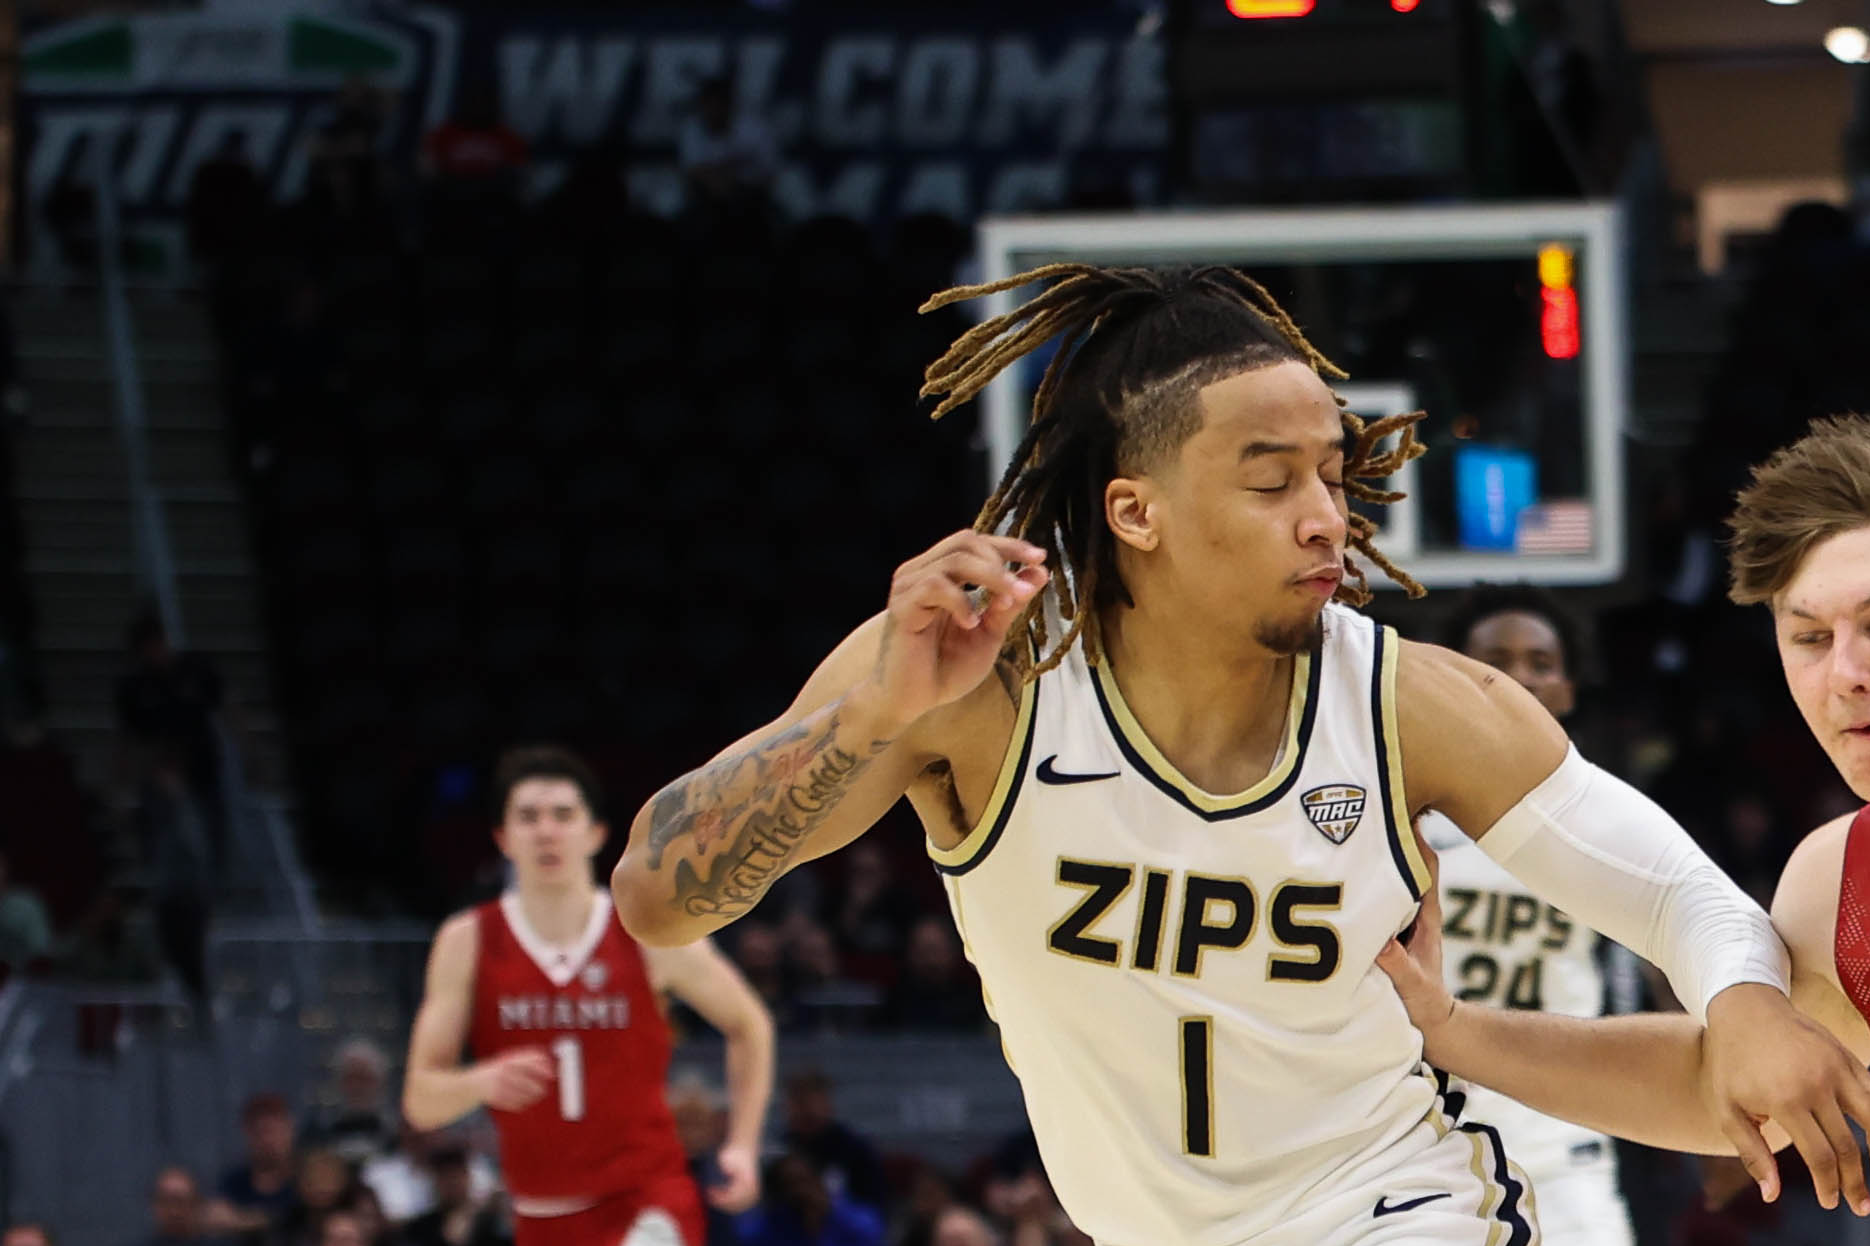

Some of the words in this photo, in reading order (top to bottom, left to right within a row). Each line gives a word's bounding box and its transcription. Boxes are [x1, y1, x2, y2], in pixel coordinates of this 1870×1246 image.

[1308, 800, 1363, 822] MAC
[1046, 856, 1344, 982] ZIPS
[1441, 888, 1573, 949] ZIPS
[1454, 953, 1543, 1010] 24
[498, 995, 630, 1030] MIAMI
[554, 1037, 585, 1121] 1
[1178, 1016, 1215, 1158] 1
